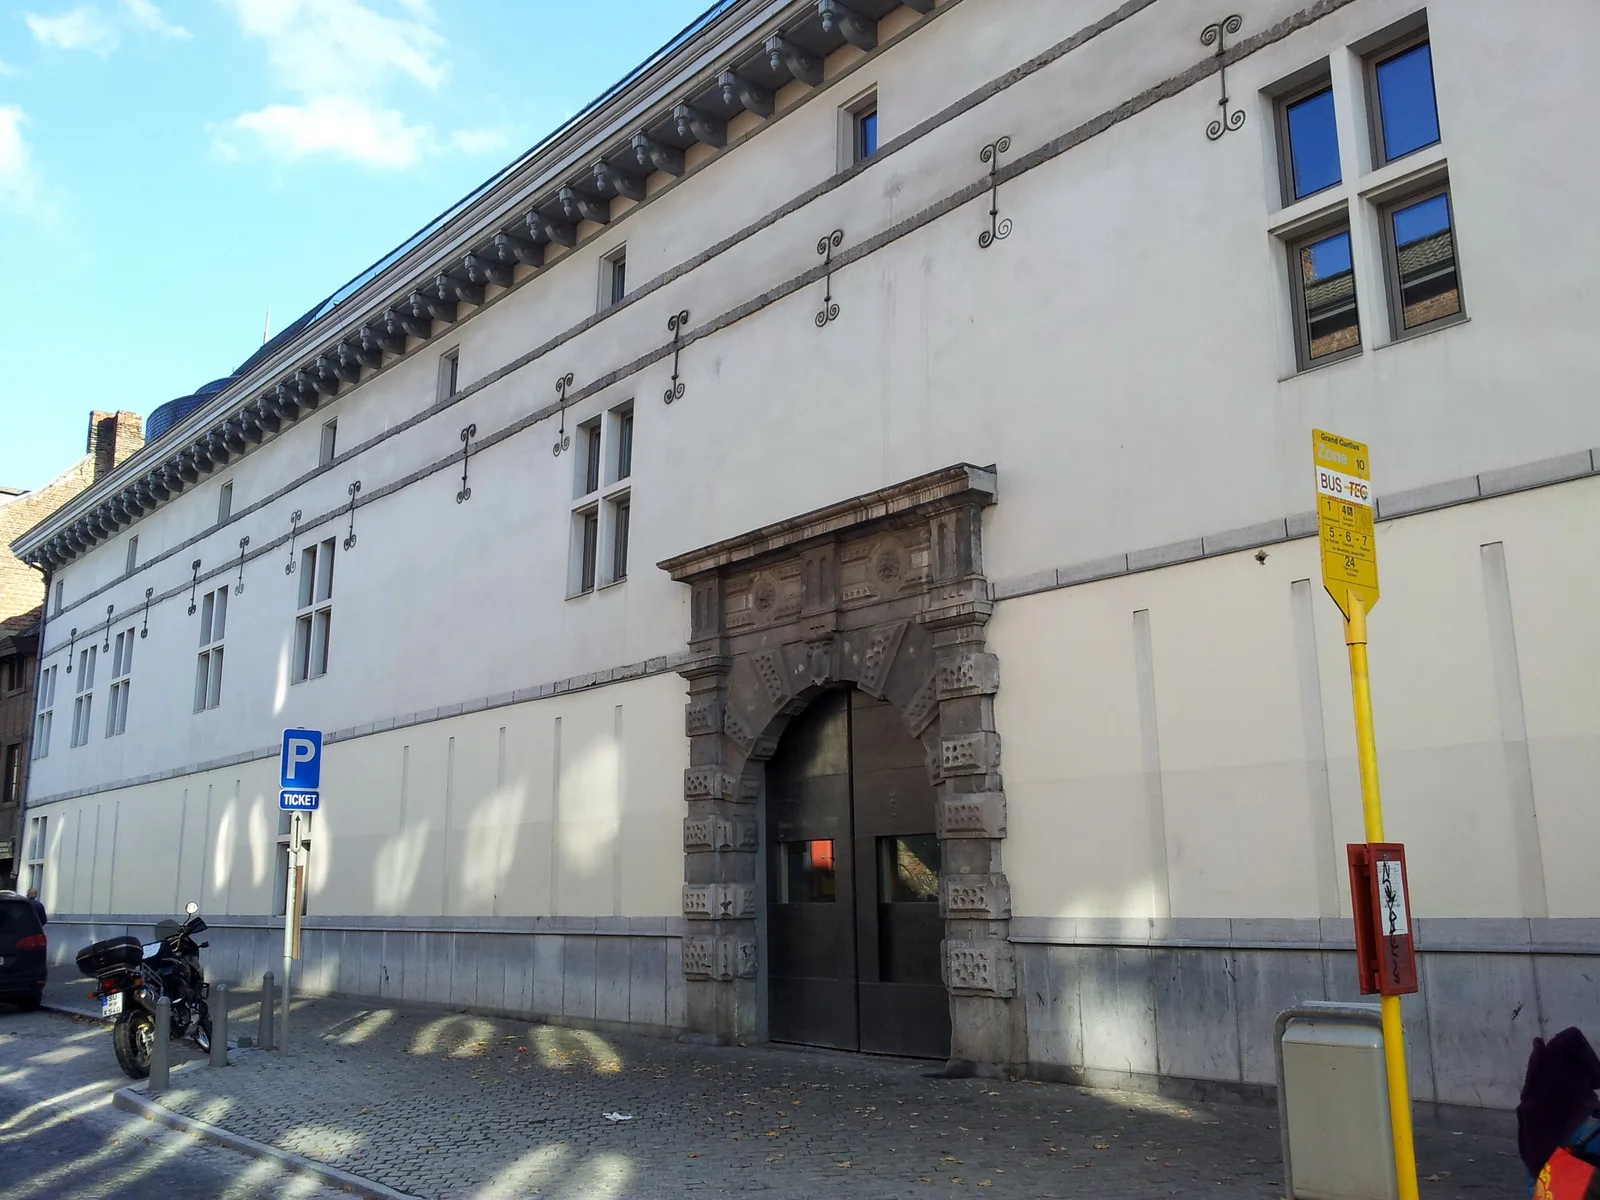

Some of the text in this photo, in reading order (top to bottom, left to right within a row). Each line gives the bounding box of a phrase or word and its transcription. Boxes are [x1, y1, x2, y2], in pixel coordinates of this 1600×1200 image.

[1320, 432, 1338, 445] Grand
[1318, 442, 1365, 471] Zone 10
[1320, 472, 1369, 500] BUS TEC
[1327, 501, 1332, 511] 1
[1329, 526, 1335, 538] 5
[1345, 531, 1352, 543] 6
[1362, 535, 1368, 546] 7
[1344, 555, 1356, 568] 24
[286, 738, 316, 779] P
[283, 793, 318, 806] TICKET
